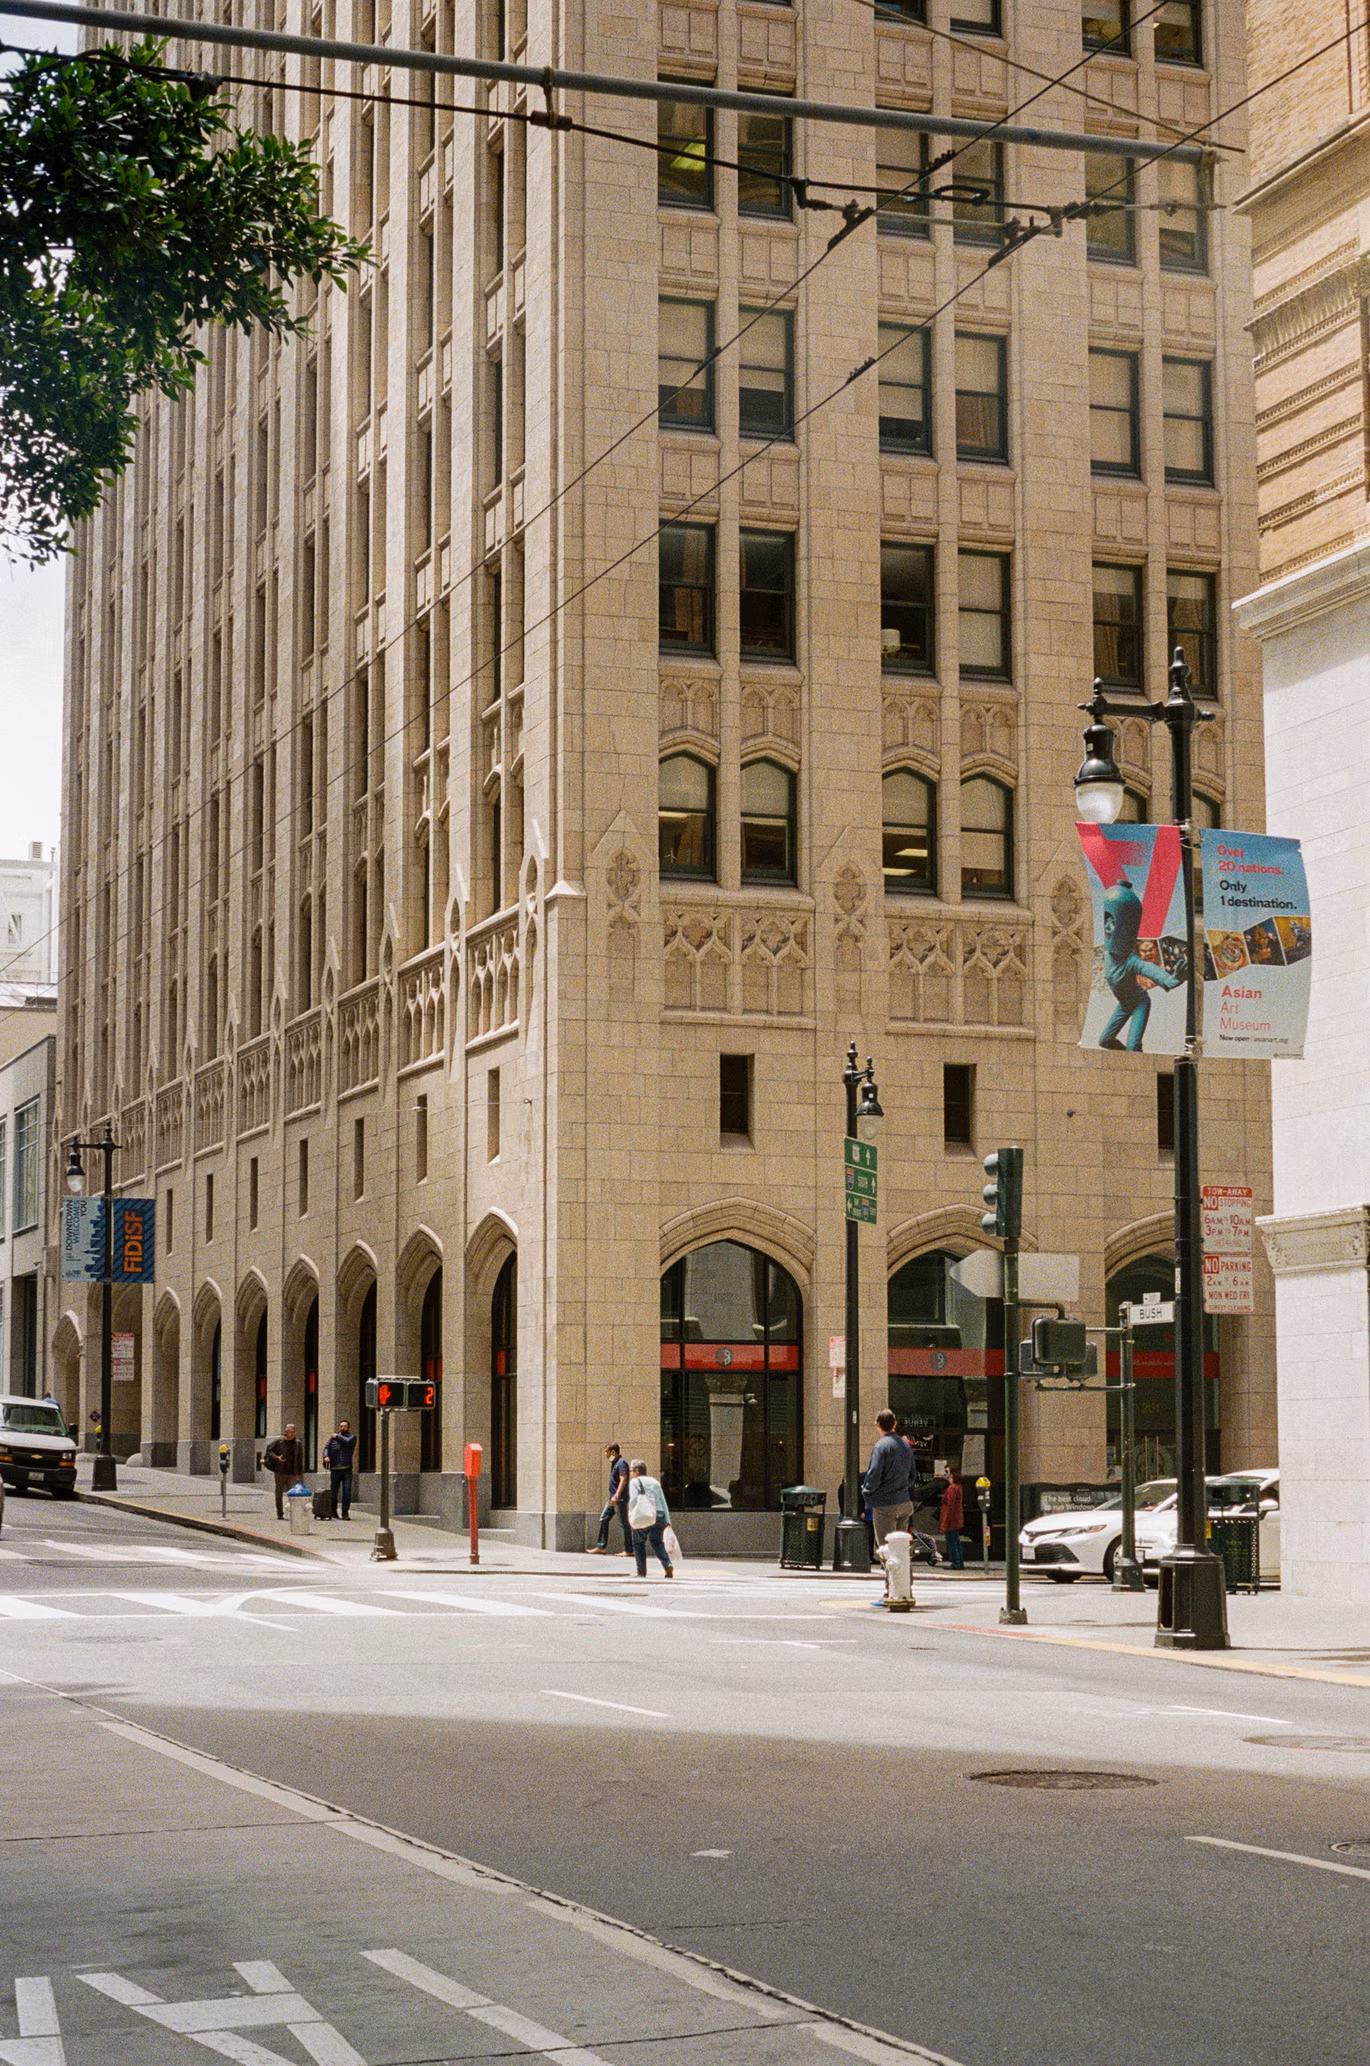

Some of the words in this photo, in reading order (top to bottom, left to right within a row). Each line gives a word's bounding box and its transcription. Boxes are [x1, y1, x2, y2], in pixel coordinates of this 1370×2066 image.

[1217, 844, 1246, 857] Over
[1218, 860, 1236, 872] 20
[1238, 864, 1285, 875] nations.
[1220, 880, 1247, 894] Only
[1220, 895, 1226, 906] 1
[1227, 896, 1298, 910] destination.
[1221, 985, 1263, 999] Asian
[1220, 1001, 1240, 1014] Art
[1220, 1017, 1271, 1032] Museum
[1206, 1187, 1248, 1196] TOW-AWAY
[1203, 1196, 1218, 1209] NO
[1219, 1198, 1251, 1208] STOPPING
[73, 1199, 81, 1244] WELCOMES
[1204, 1257, 1219, 1273] NO
[1220, 1261, 1252, 1272] PARKING
[1208, 1291, 1222, 1300] MON
[1224, 1291, 1238, 1300] WED
[1239, 1291, 1250, 1300] FRI
[1139, 1307, 1163, 1320] BUSH
[425, 1386, 434, 1405] 2
